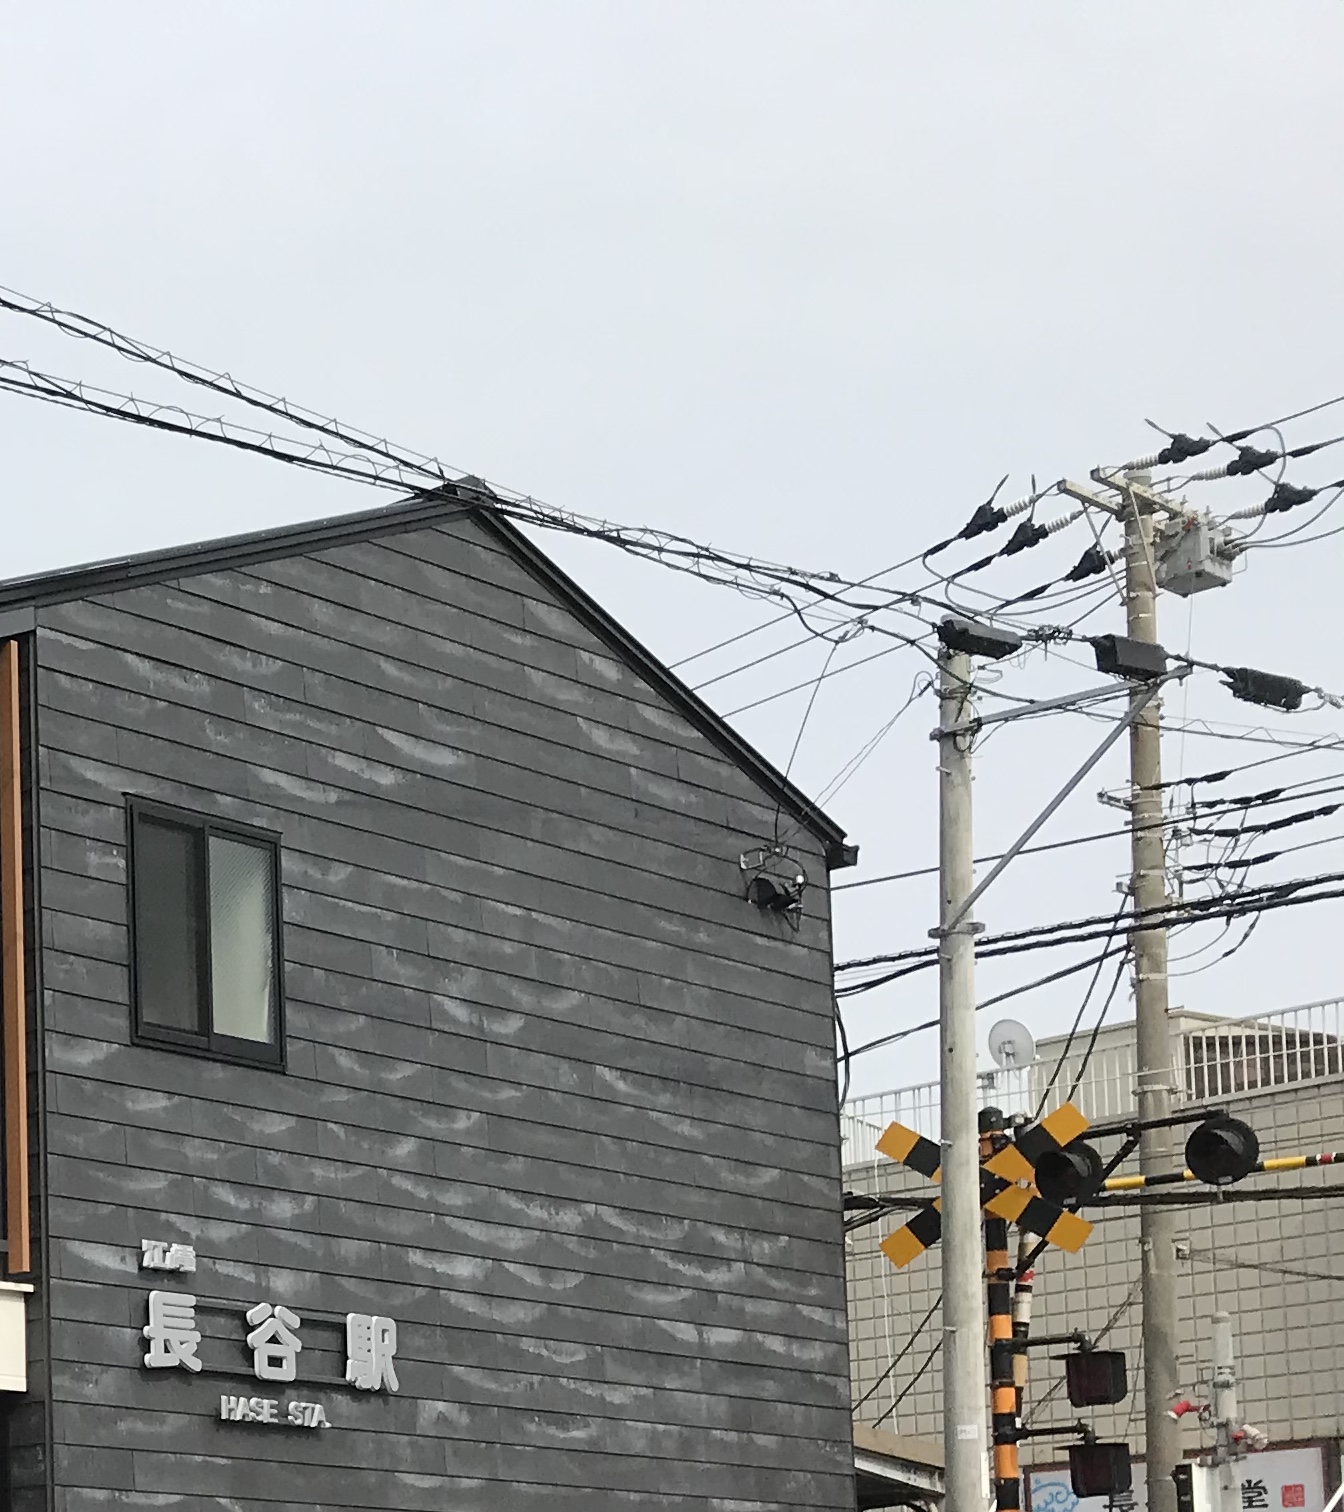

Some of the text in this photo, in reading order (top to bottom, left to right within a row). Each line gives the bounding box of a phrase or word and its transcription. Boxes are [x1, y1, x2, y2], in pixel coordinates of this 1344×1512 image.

[143, 1290, 400, 1393] 長谷駅
[220, 1395, 332, 1429] HASE STA.
